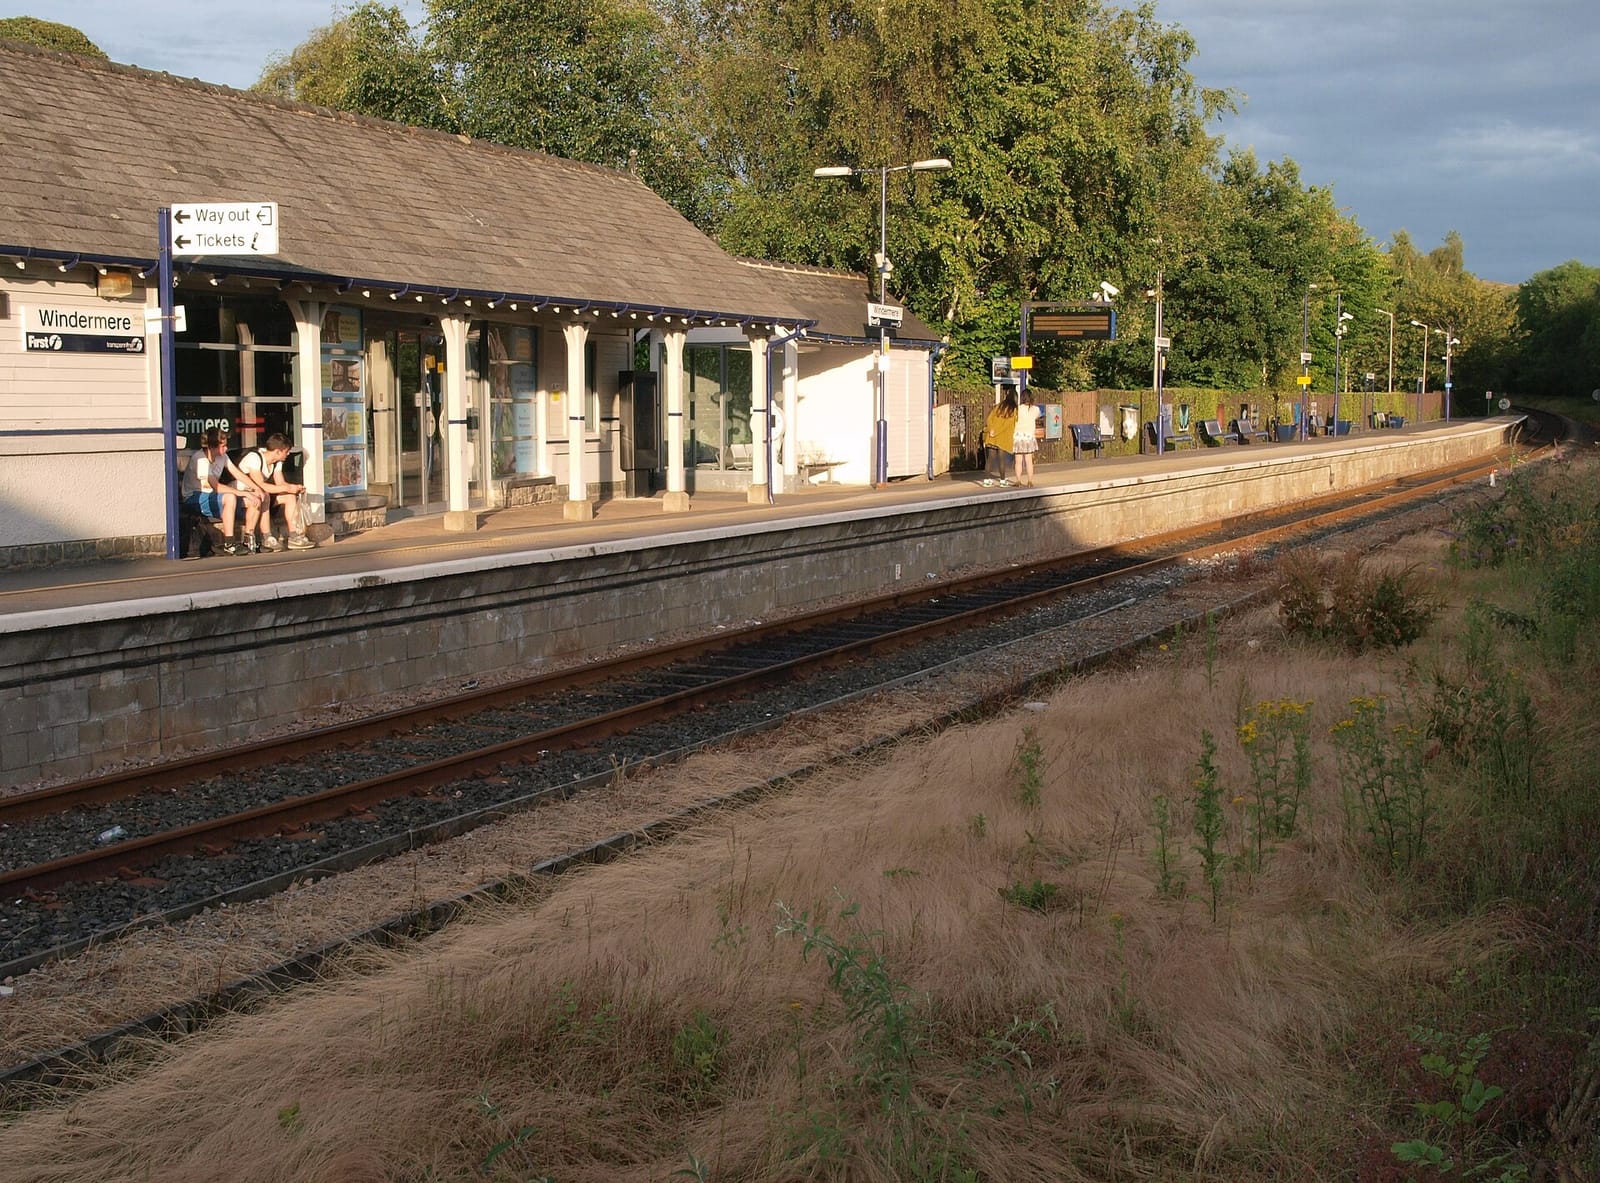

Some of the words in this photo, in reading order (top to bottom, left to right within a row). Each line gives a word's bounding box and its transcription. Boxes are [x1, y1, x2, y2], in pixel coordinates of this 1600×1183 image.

[195, 209, 224, 224] Way
[228, 208, 250, 221] out
[196, 233, 245, 247] Tickets
[38, 308, 131, 331] Windermere
[28, 335, 50, 349] First
[176, 418, 230, 434] ermere
